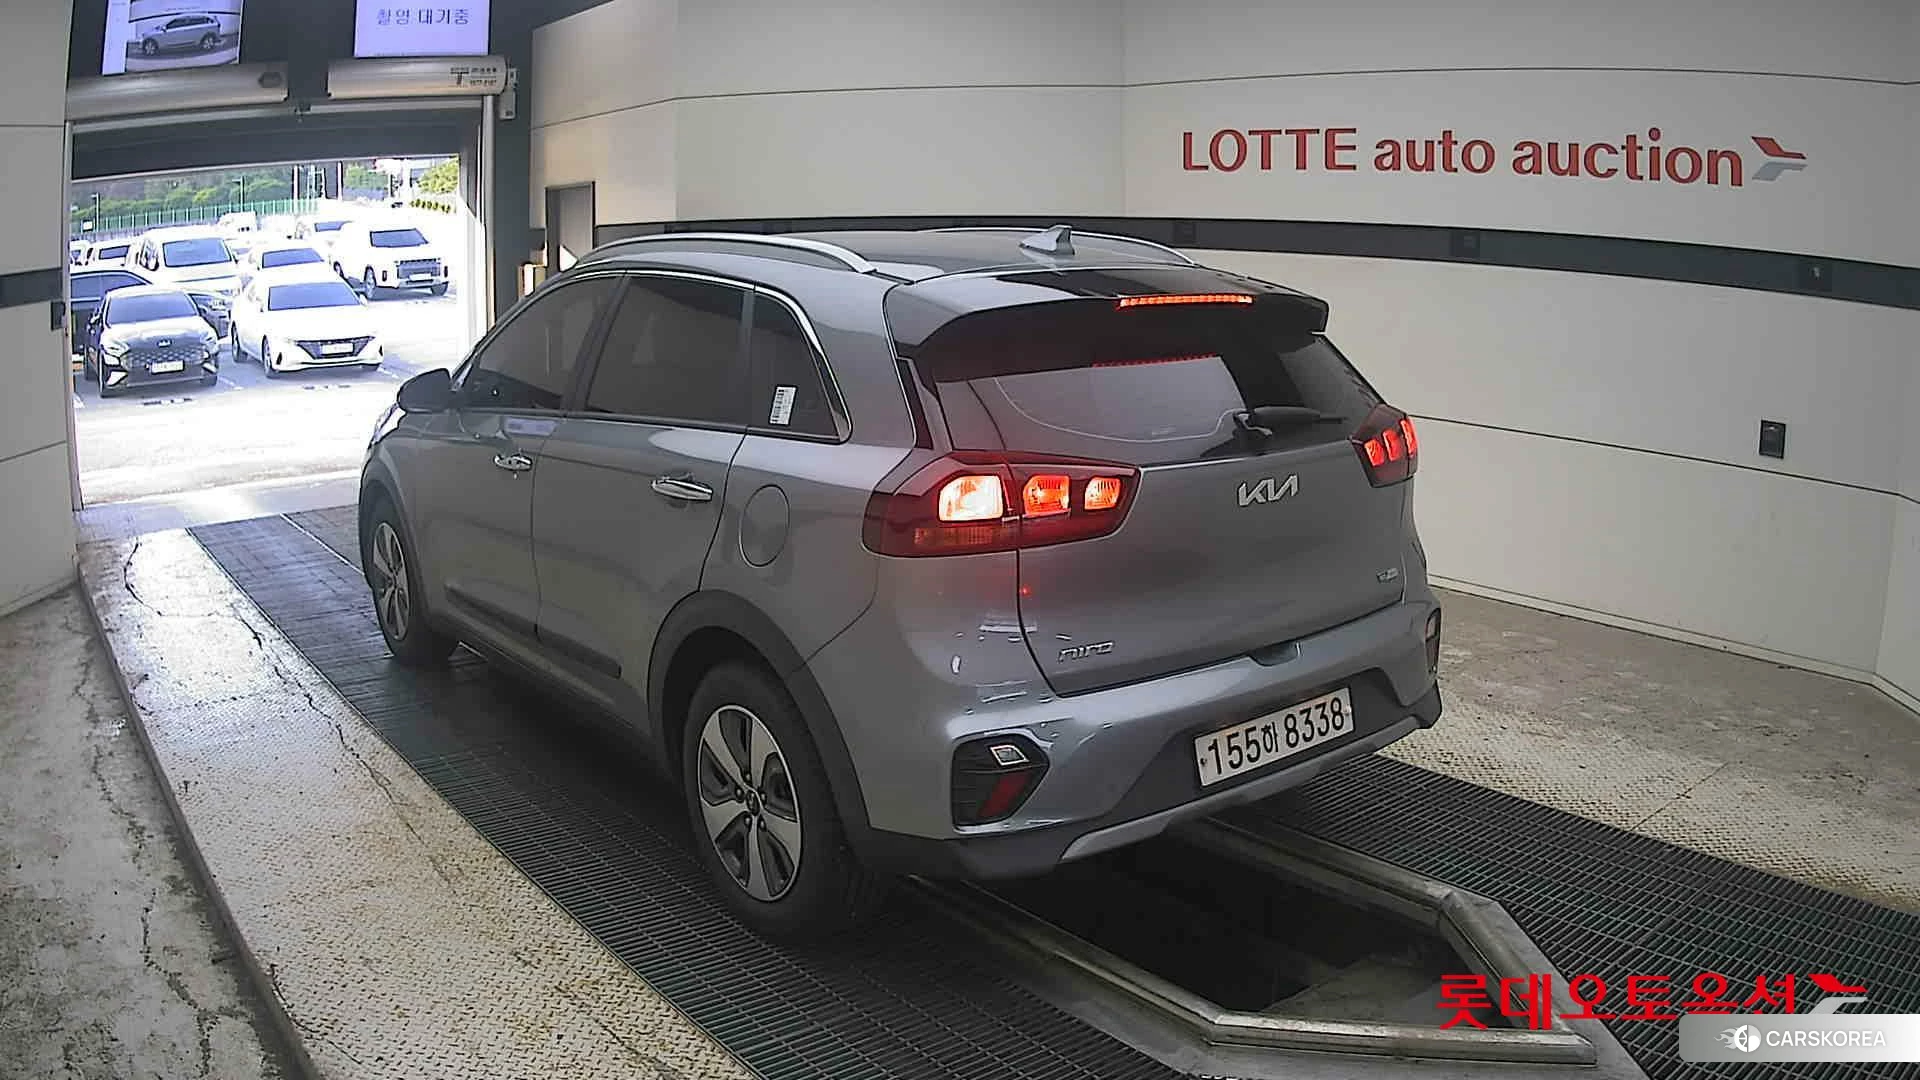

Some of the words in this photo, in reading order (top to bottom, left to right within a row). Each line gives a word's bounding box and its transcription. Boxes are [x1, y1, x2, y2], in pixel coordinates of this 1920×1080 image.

[418, 9, 470, 26] 대기중
[1182, 128, 1356, 172] LOTTE
[1374, 131, 1496, 174] auto
[1512, 127, 1743, 187] auction
[1284, 697, 1345, 749] 8338
